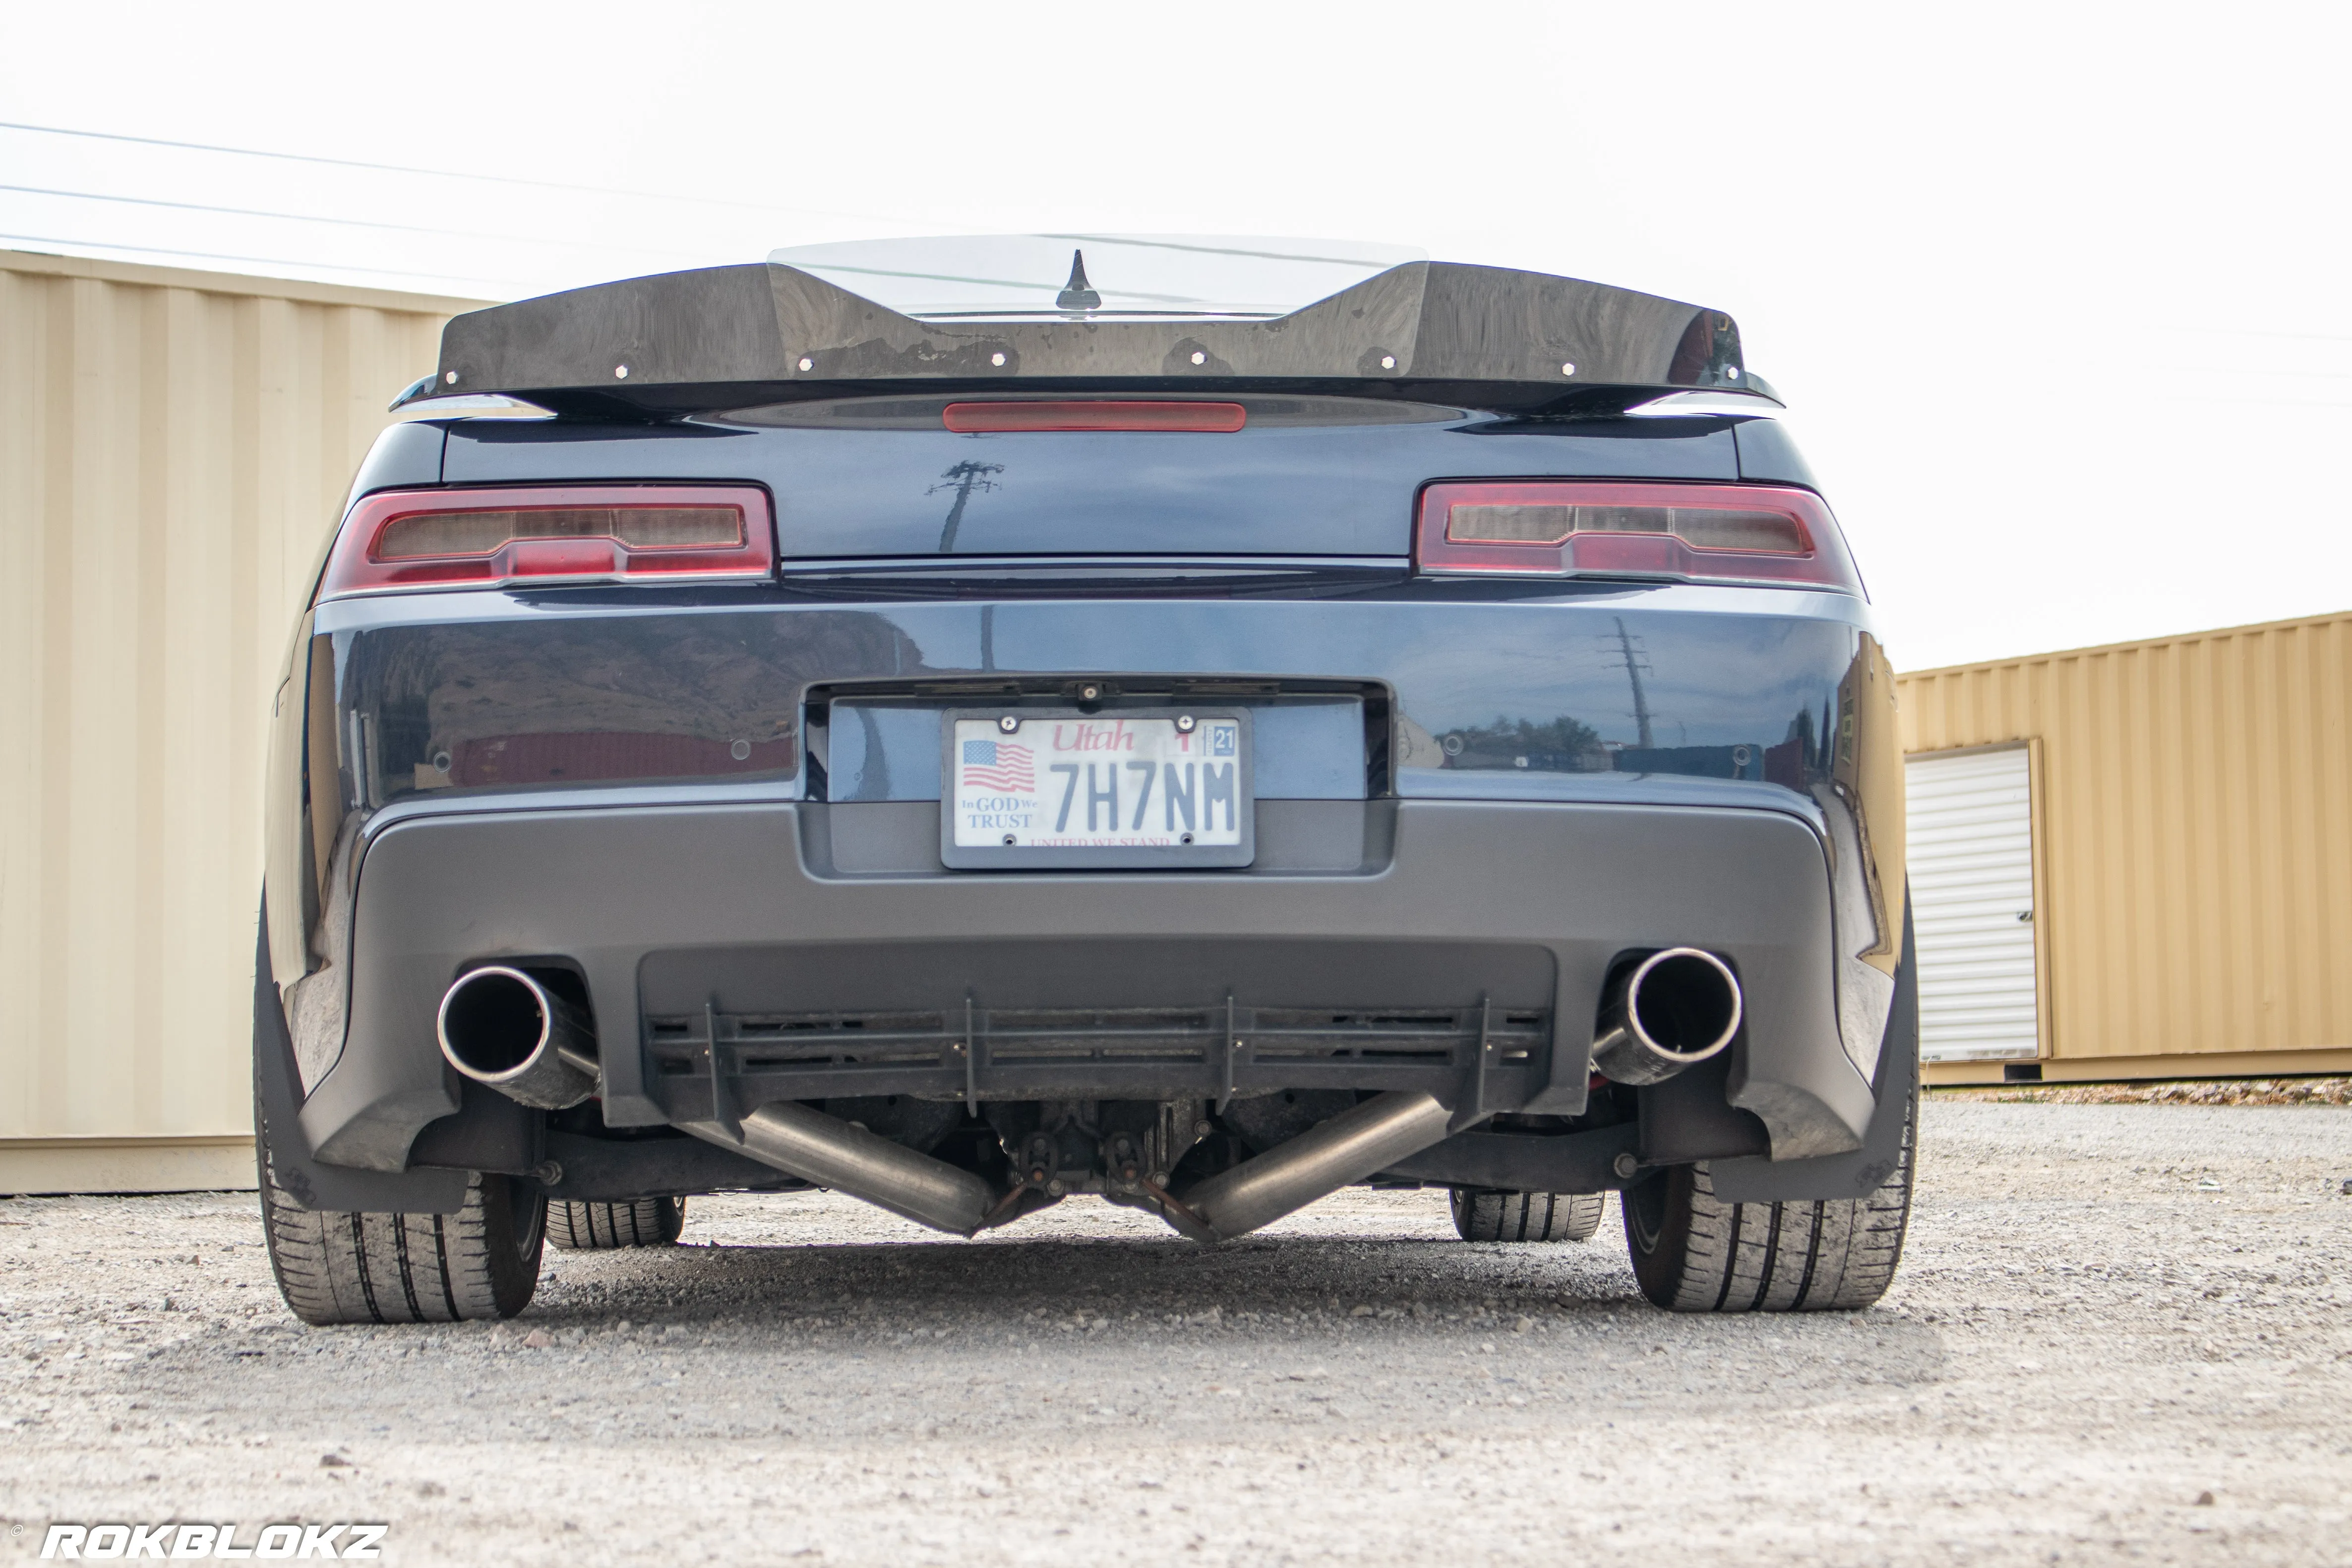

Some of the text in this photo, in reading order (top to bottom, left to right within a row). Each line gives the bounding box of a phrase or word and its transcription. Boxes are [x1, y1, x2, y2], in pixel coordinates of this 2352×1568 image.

[1053, 719, 1135, 751] Utah
[1215, 729, 1233, 748] 21
[962, 797, 1038, 812] In GOD We
[1049, 761, 1235, 833] 7H7NM
[967, 814, 1032, 828] TRUST
[1119, 838, 1170, 846] STAND
